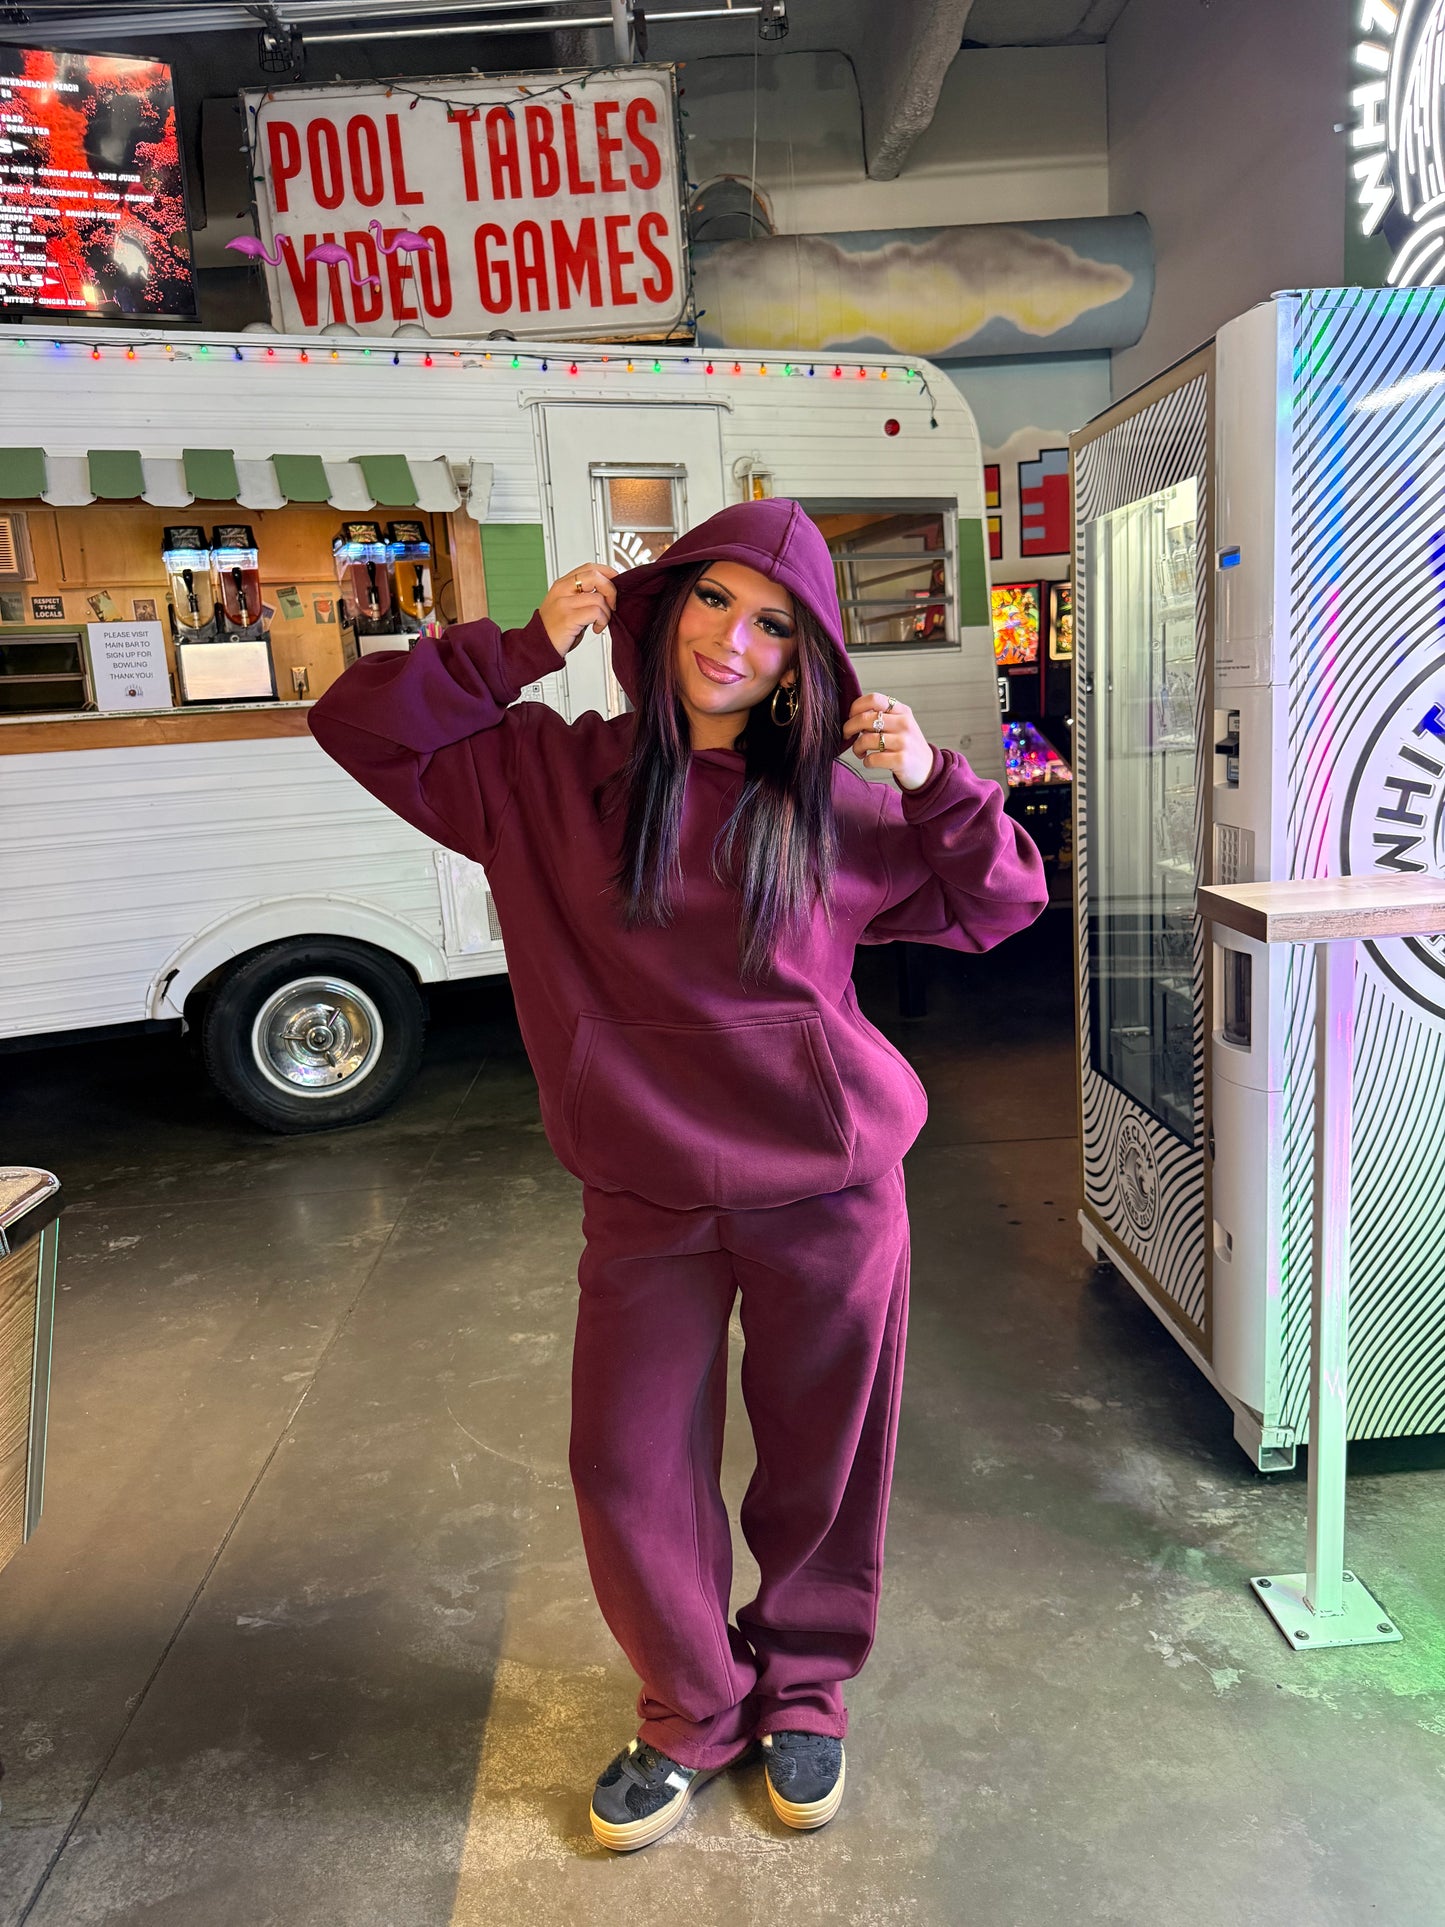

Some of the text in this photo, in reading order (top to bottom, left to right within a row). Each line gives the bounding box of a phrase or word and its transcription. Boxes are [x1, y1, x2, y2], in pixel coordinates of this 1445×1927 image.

[266, 97, 662, 212] POOL TABLES
[283, 211, 674, 327] VIDEO GAMES
[103, 630, 149, 639] PLEASE VISIT
[105, 641, 124, 649] MAIN
[113, 661, 148, 669] BOWLING
[1118, 1125, 1154, 1175] WHITE CLAW
